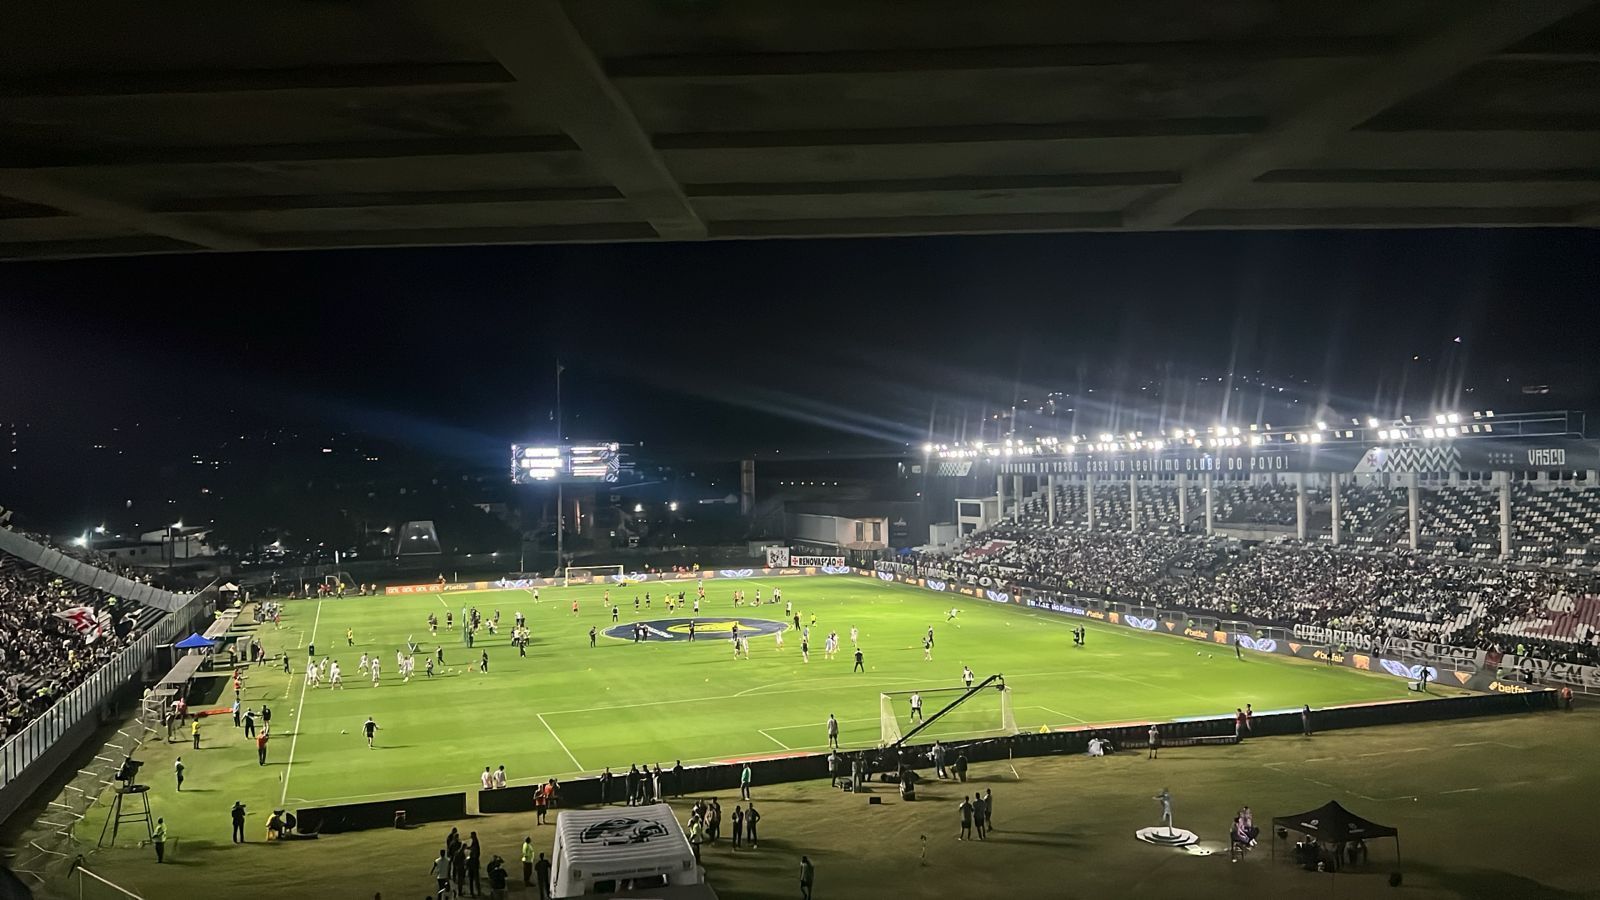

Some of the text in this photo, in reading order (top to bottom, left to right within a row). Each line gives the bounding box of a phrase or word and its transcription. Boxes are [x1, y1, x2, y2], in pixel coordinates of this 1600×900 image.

[1229, 457, 1242, 471] DO
[1251, 456, 1289, 470] POVO!
[1528, 449, 1565, 465] VASCO
[1293, 623, 1371, 650] GUERREIROS
